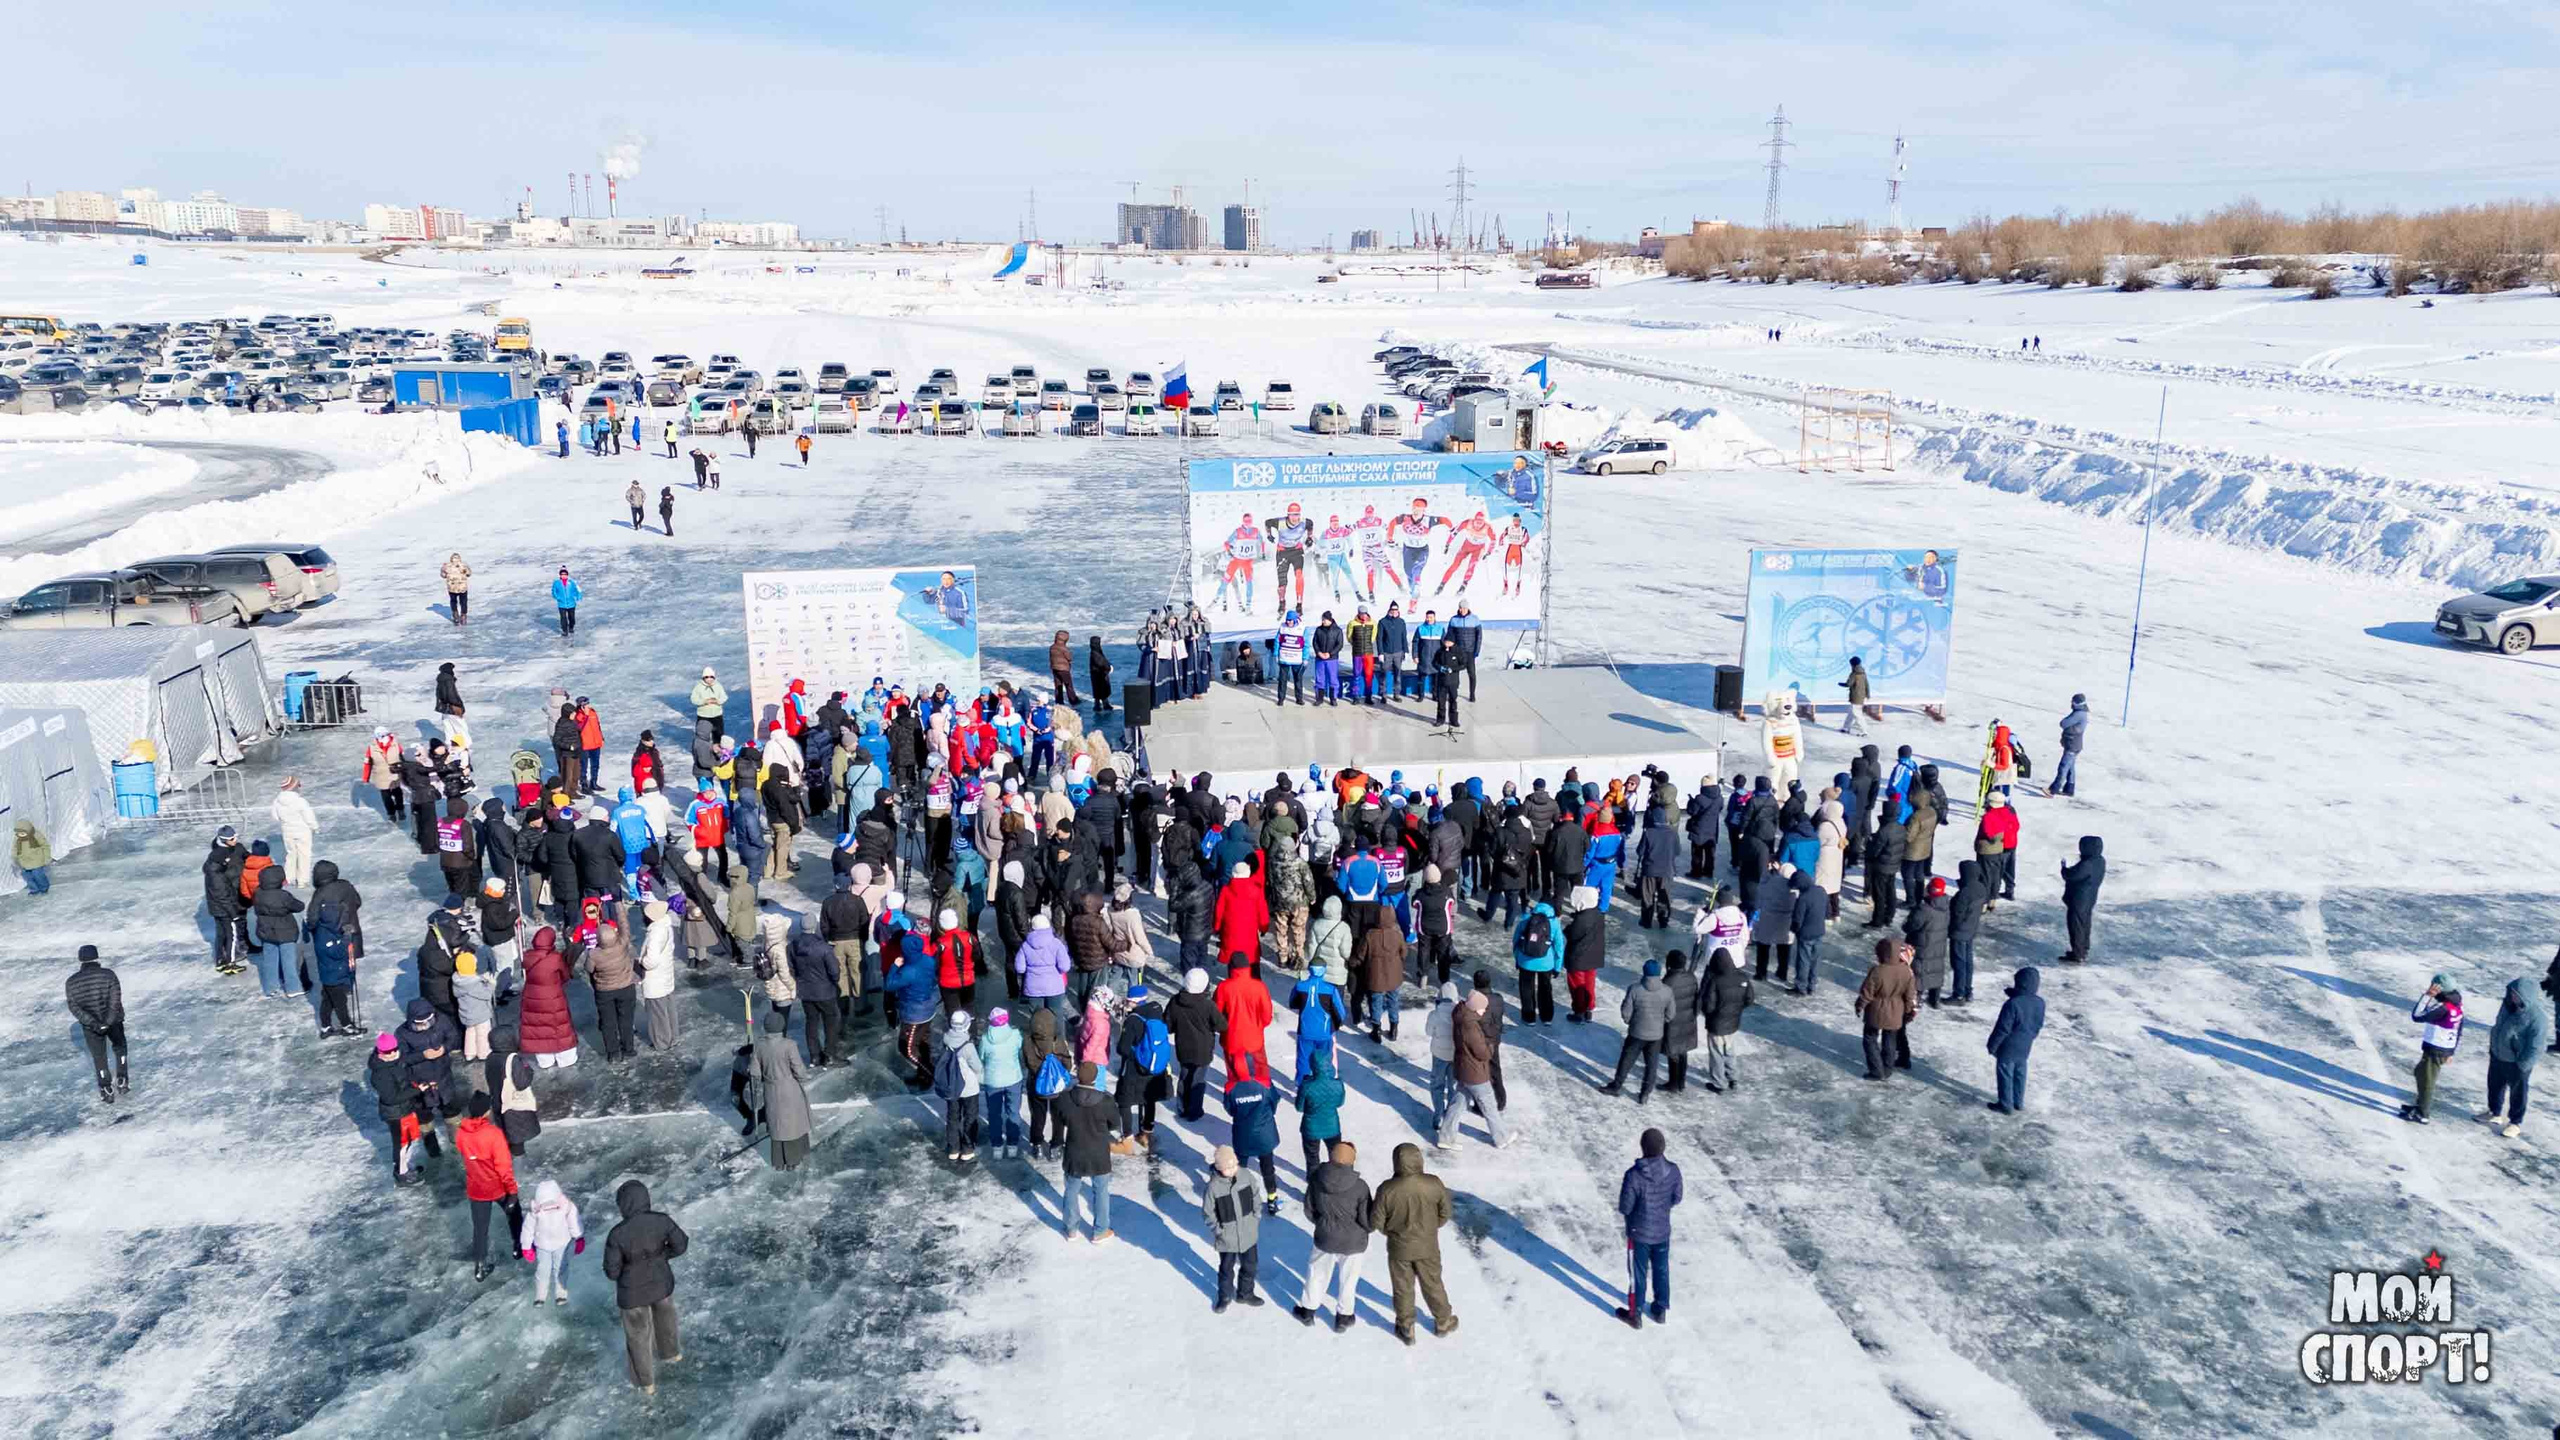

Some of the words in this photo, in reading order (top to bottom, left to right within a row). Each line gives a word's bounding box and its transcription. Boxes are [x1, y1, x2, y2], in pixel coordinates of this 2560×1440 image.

[1281, 464, 1301, 475] 100
[1304, 463, 1324, 474] ЛЕТ
[1326, 461, 1391, 474] ЛЫЖНОМУ
[1393, 461, 1440, 472] СПОРТУ
[1283, 475, 1290, 484] В
[1292, 473, 1357, 484] РЕСПУБЛИКЕ
[1359, 472, 1389, 482] САХА
[1391, 471, 1437, 483] (ЯКУТИЯ)
